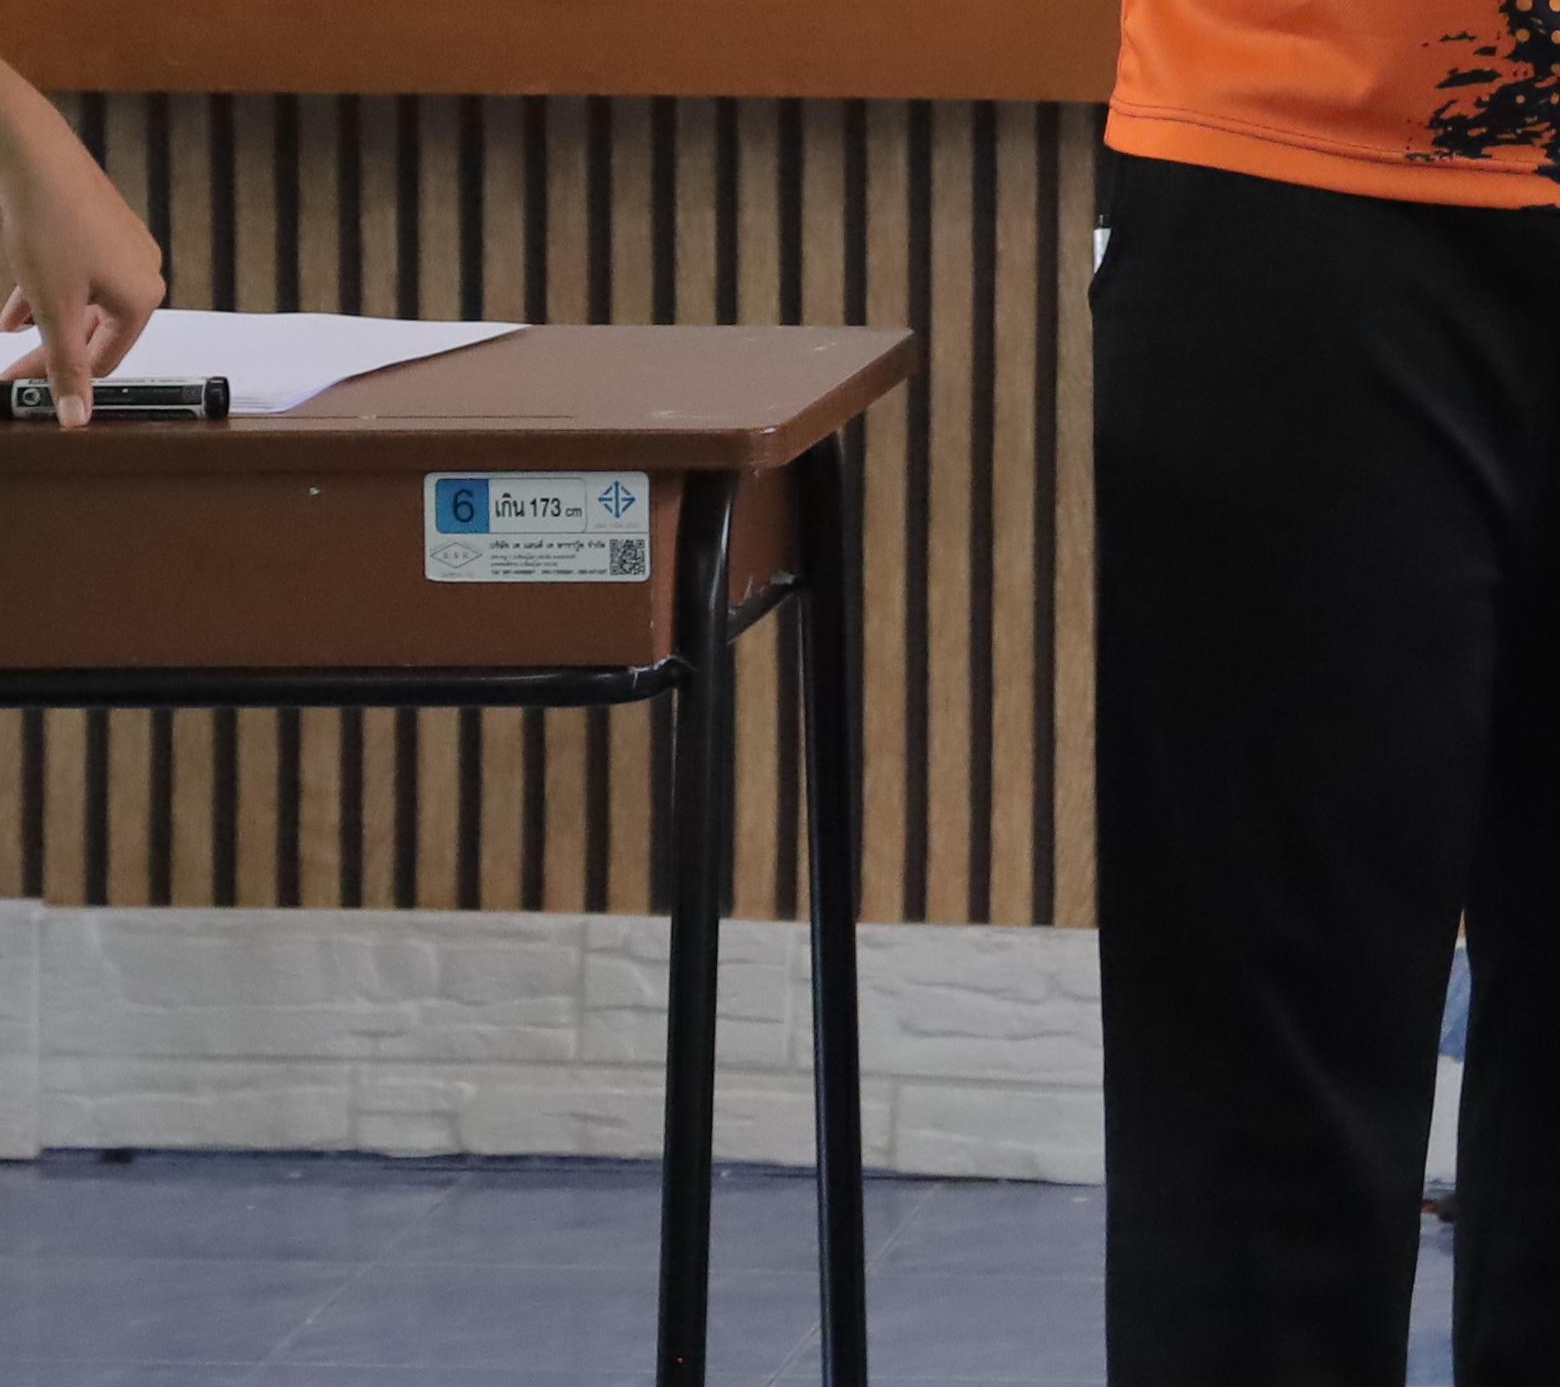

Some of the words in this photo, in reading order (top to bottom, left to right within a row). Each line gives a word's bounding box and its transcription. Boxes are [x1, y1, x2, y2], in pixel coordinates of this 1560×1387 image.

[453, 489, 474, 522] 6
[495, 493, 525, 518] เกิน
[530, 498, 561, 518] 173
[565, 507, 583, 518] cm
